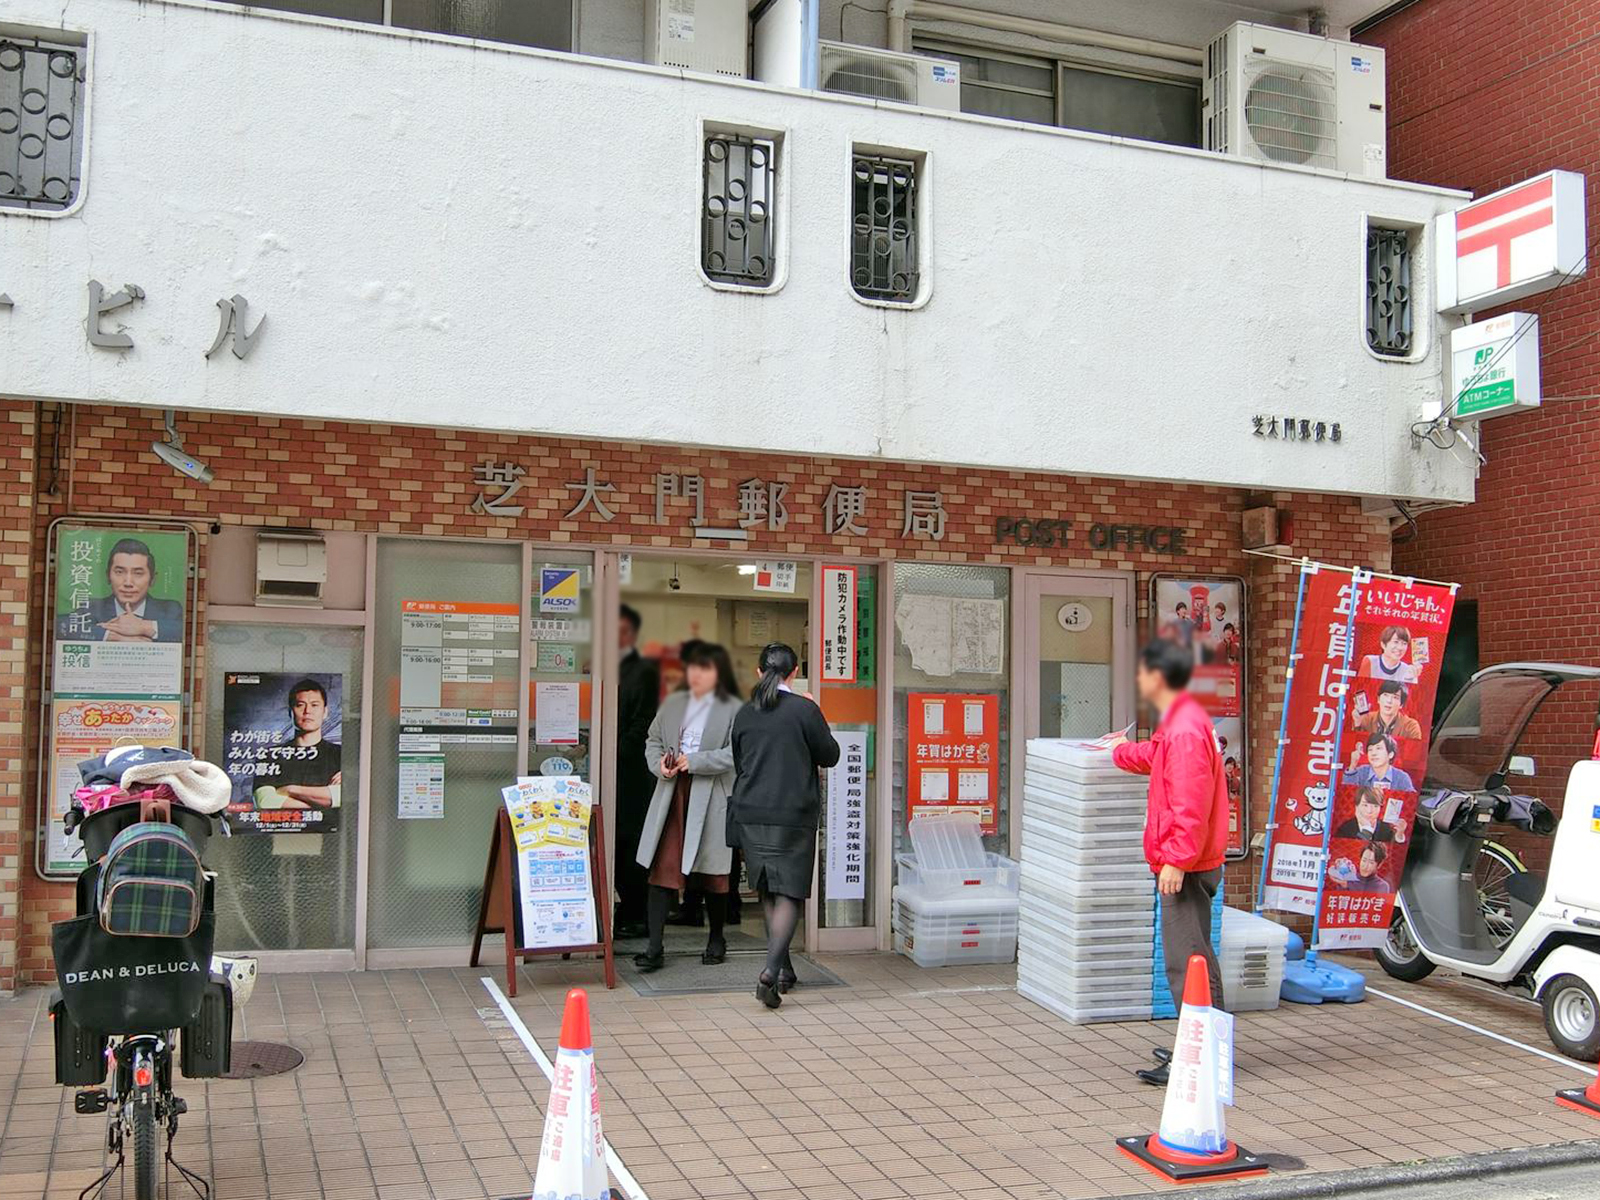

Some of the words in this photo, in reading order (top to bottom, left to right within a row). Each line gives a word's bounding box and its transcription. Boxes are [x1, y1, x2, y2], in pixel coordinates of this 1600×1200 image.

[1463, 386, 1511, 404] ATMコーナー
[1252, 414, 1343, 442] 芝大門郵便局
[471, 460, 948, 542] 芝大門郵便局
[996, 516, 1072, 549] POST
[1088, 522, 1189, 556] OFFICE
[777, 562, 794, 572] 郵便
[776, 572, 792, 581] 切手
[69, 540, 93, 634] 投資信託
[542, 598, 577, 606] ALSOK
[1366, 589, 1447, 614] いいじゃん、
[837, 572, 848, 677] 防犯カメラ作動中です
[62, 654, 91, 669] 投信
[825, 639, 833, 671] 郵便局長
[1305, 583, 1363, 776] 年賀はがき
[229, 730, 284, 744] わが街を
[228, 746, 319, 760] みんなで守ろう
[916, 743, 976, 760] 年賀はがき
[228, 761, 282, 776] 年の暮れ
[567, 785, 590, 797] わくわく
[845, 743, 862, 884] 全国郵便局強盗対策強化期間
[1326, 895, 1386, 912] 年賀はがき
[1325, 913, 1382, 926] 好評販売中
[65, 968, 115, 985] DEAN
[118, 966, 131, 978] &
[135, 961, 201, 977] DELUCA
